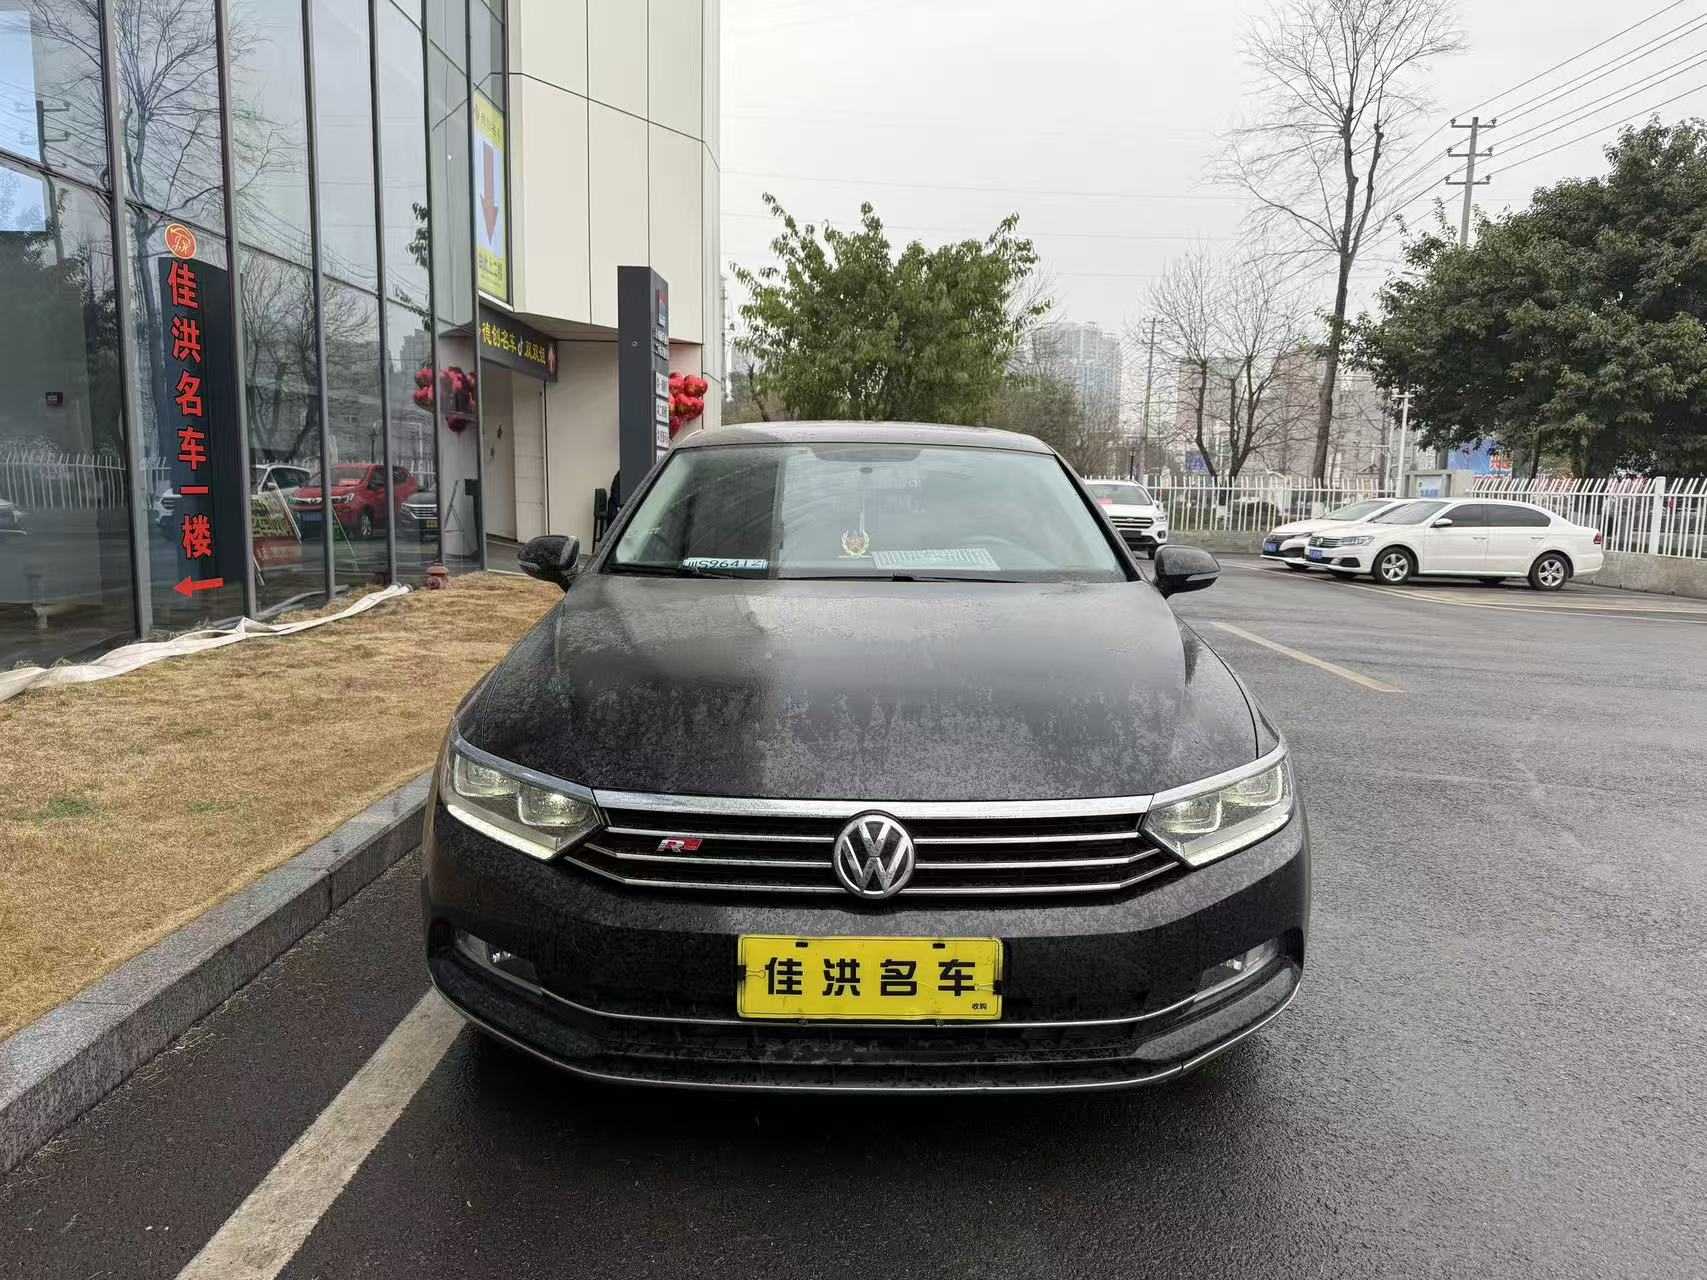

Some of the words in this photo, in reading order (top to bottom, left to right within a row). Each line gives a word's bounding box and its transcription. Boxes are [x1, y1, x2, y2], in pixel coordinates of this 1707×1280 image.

[168, 260, 212, 559] 佳洪名车一楼
[764, 957, 976, 997] 佳洪名车
